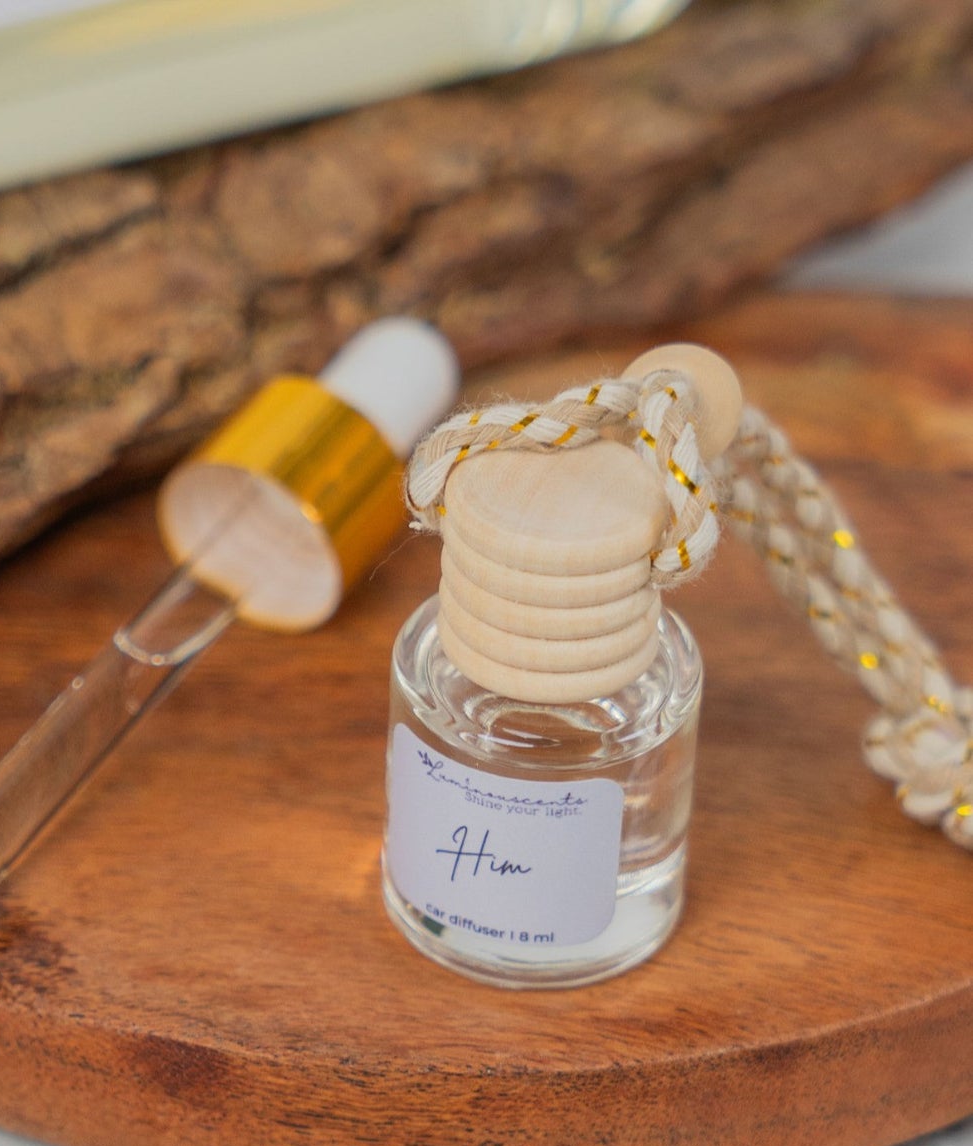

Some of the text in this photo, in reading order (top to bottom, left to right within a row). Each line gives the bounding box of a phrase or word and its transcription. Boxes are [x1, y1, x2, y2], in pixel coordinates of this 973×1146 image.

[464, 791, 503, 810] Shine
[506, 804, 539, 816] your
[435, 825, 531, 882] Him
[425, 903, 446, 919] car
[448, 914, 506, 939] diffuser
[518, 931, 529, 942] 8
[533, 931, 554, 943] ml
